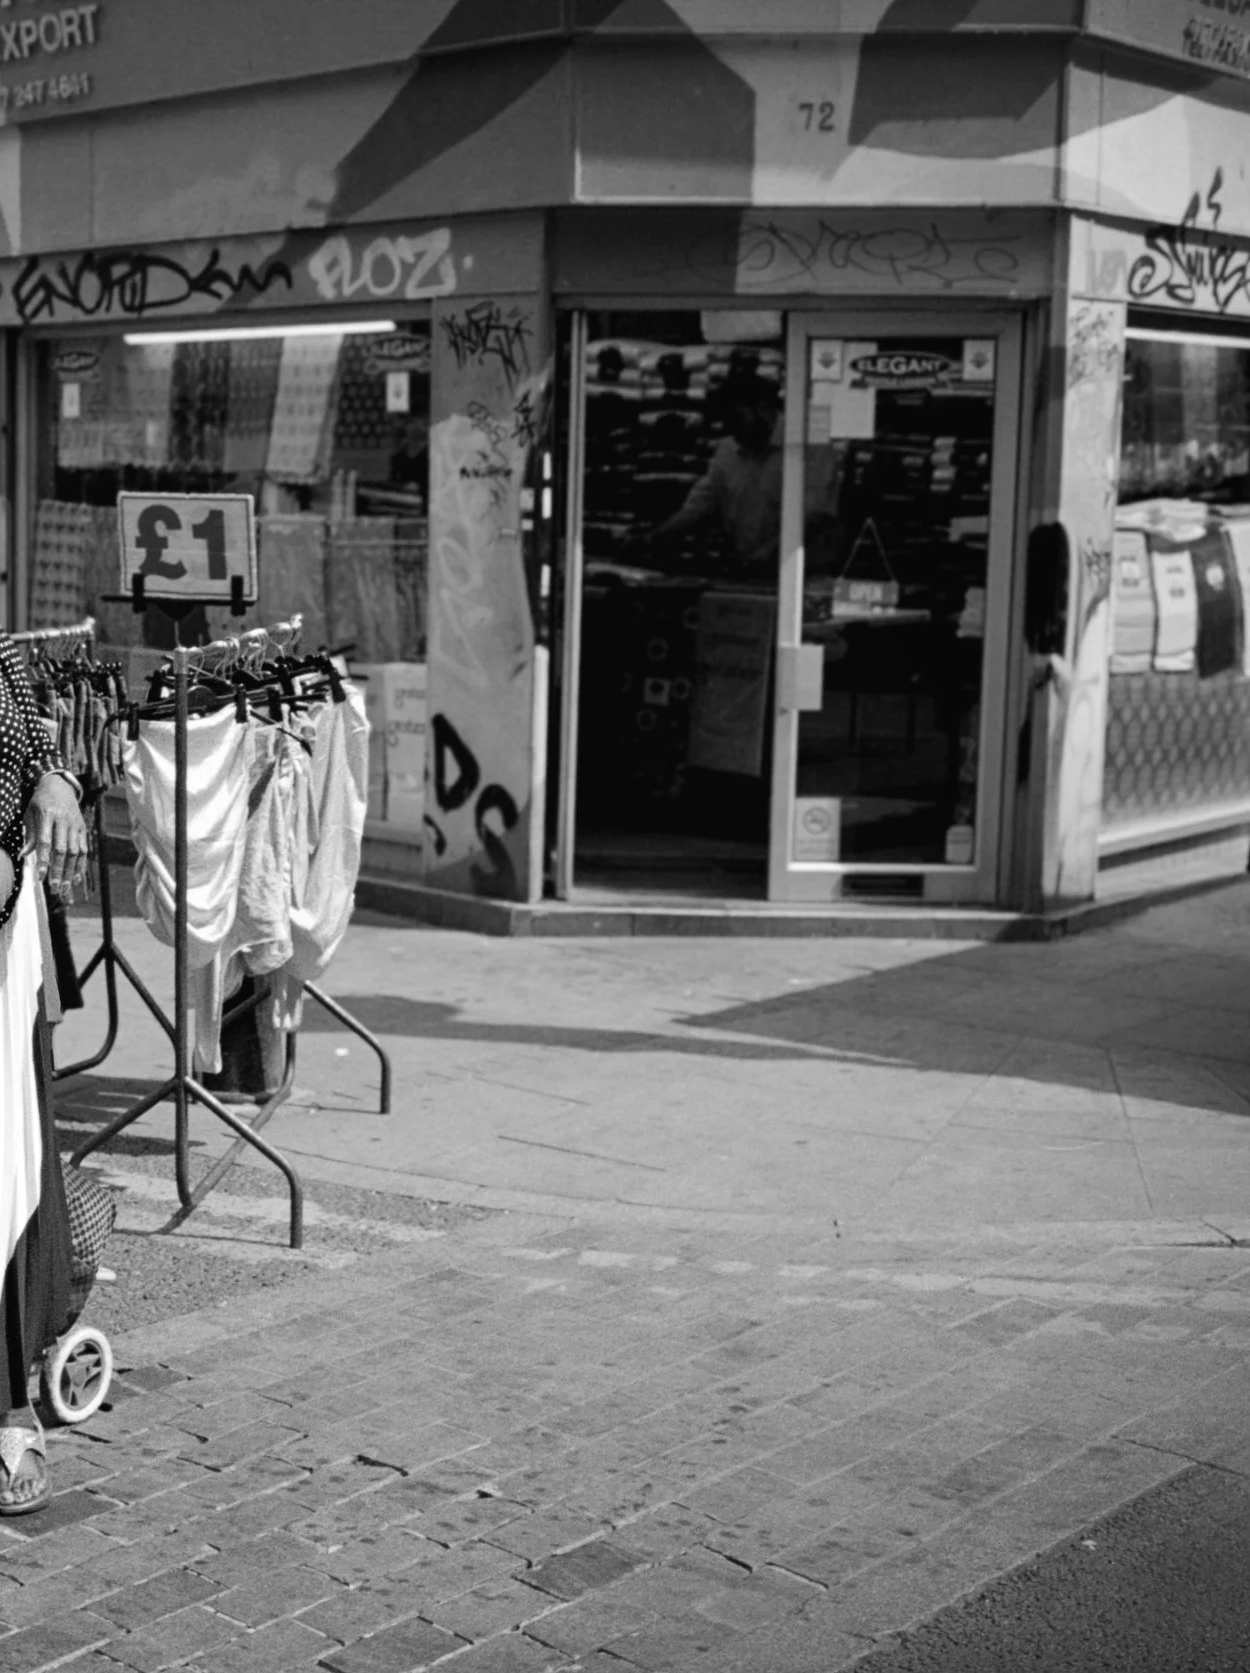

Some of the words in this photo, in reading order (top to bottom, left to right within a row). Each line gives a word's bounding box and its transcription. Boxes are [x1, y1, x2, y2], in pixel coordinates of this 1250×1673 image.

[798, 101, 836, 132] 72
[857, 356, 942, 375] ELEGANT
[135, 504, 228, 581] £1
